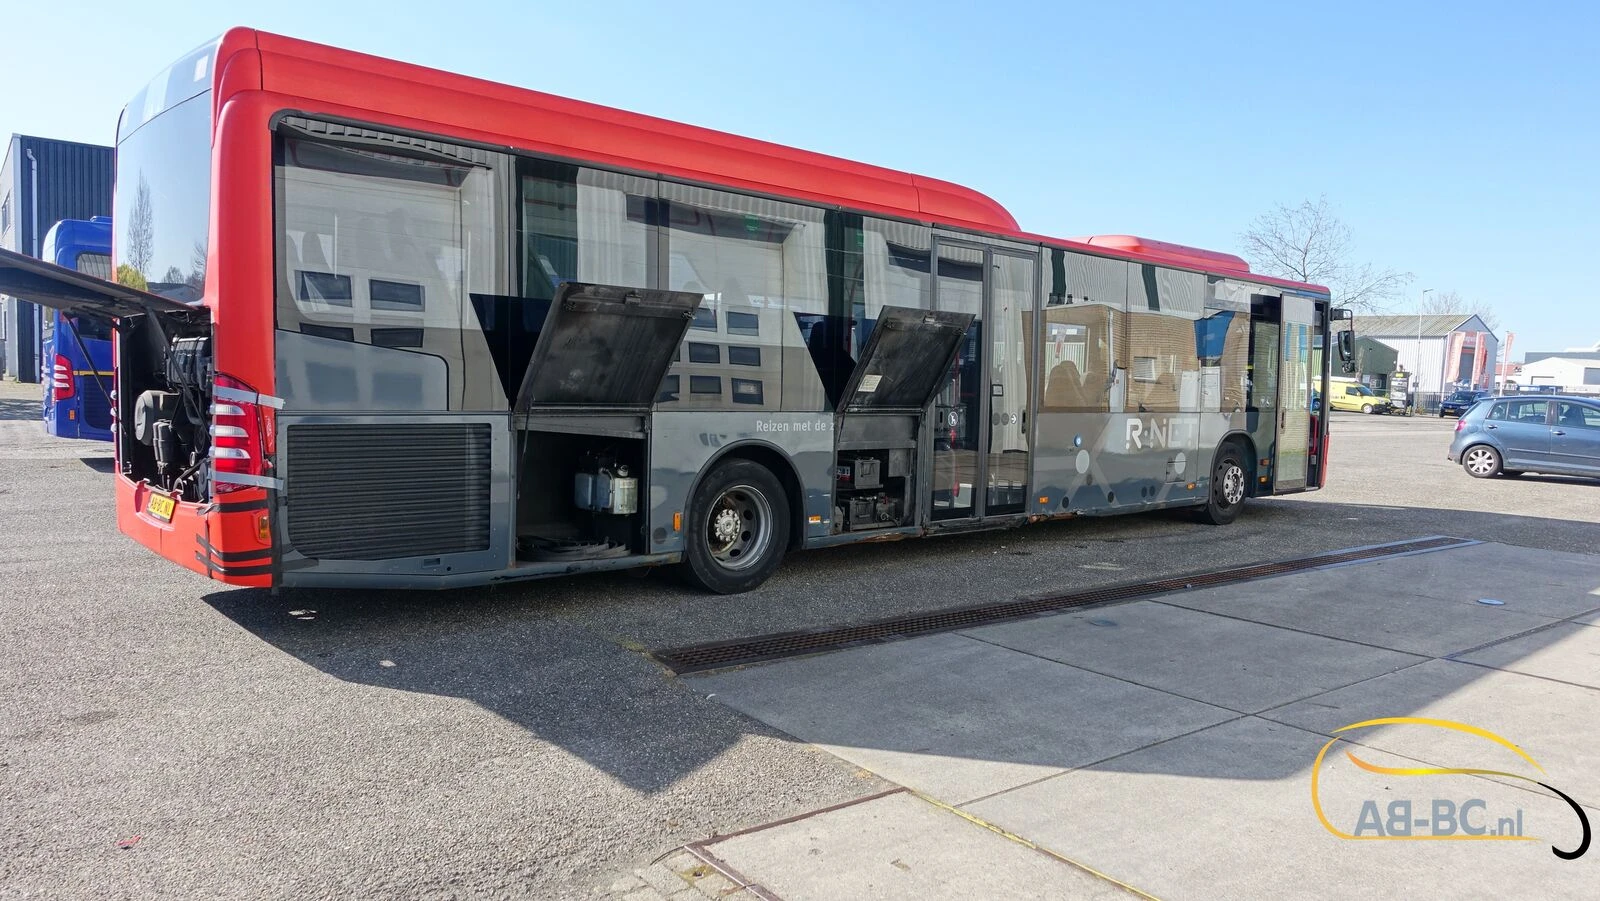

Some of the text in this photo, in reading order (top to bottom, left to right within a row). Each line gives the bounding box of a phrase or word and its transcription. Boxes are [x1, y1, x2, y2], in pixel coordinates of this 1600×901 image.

[756, 420, 789, 432] Reizen
[793, 420, 811, 432] met
[815, 419, 827, 432] de
